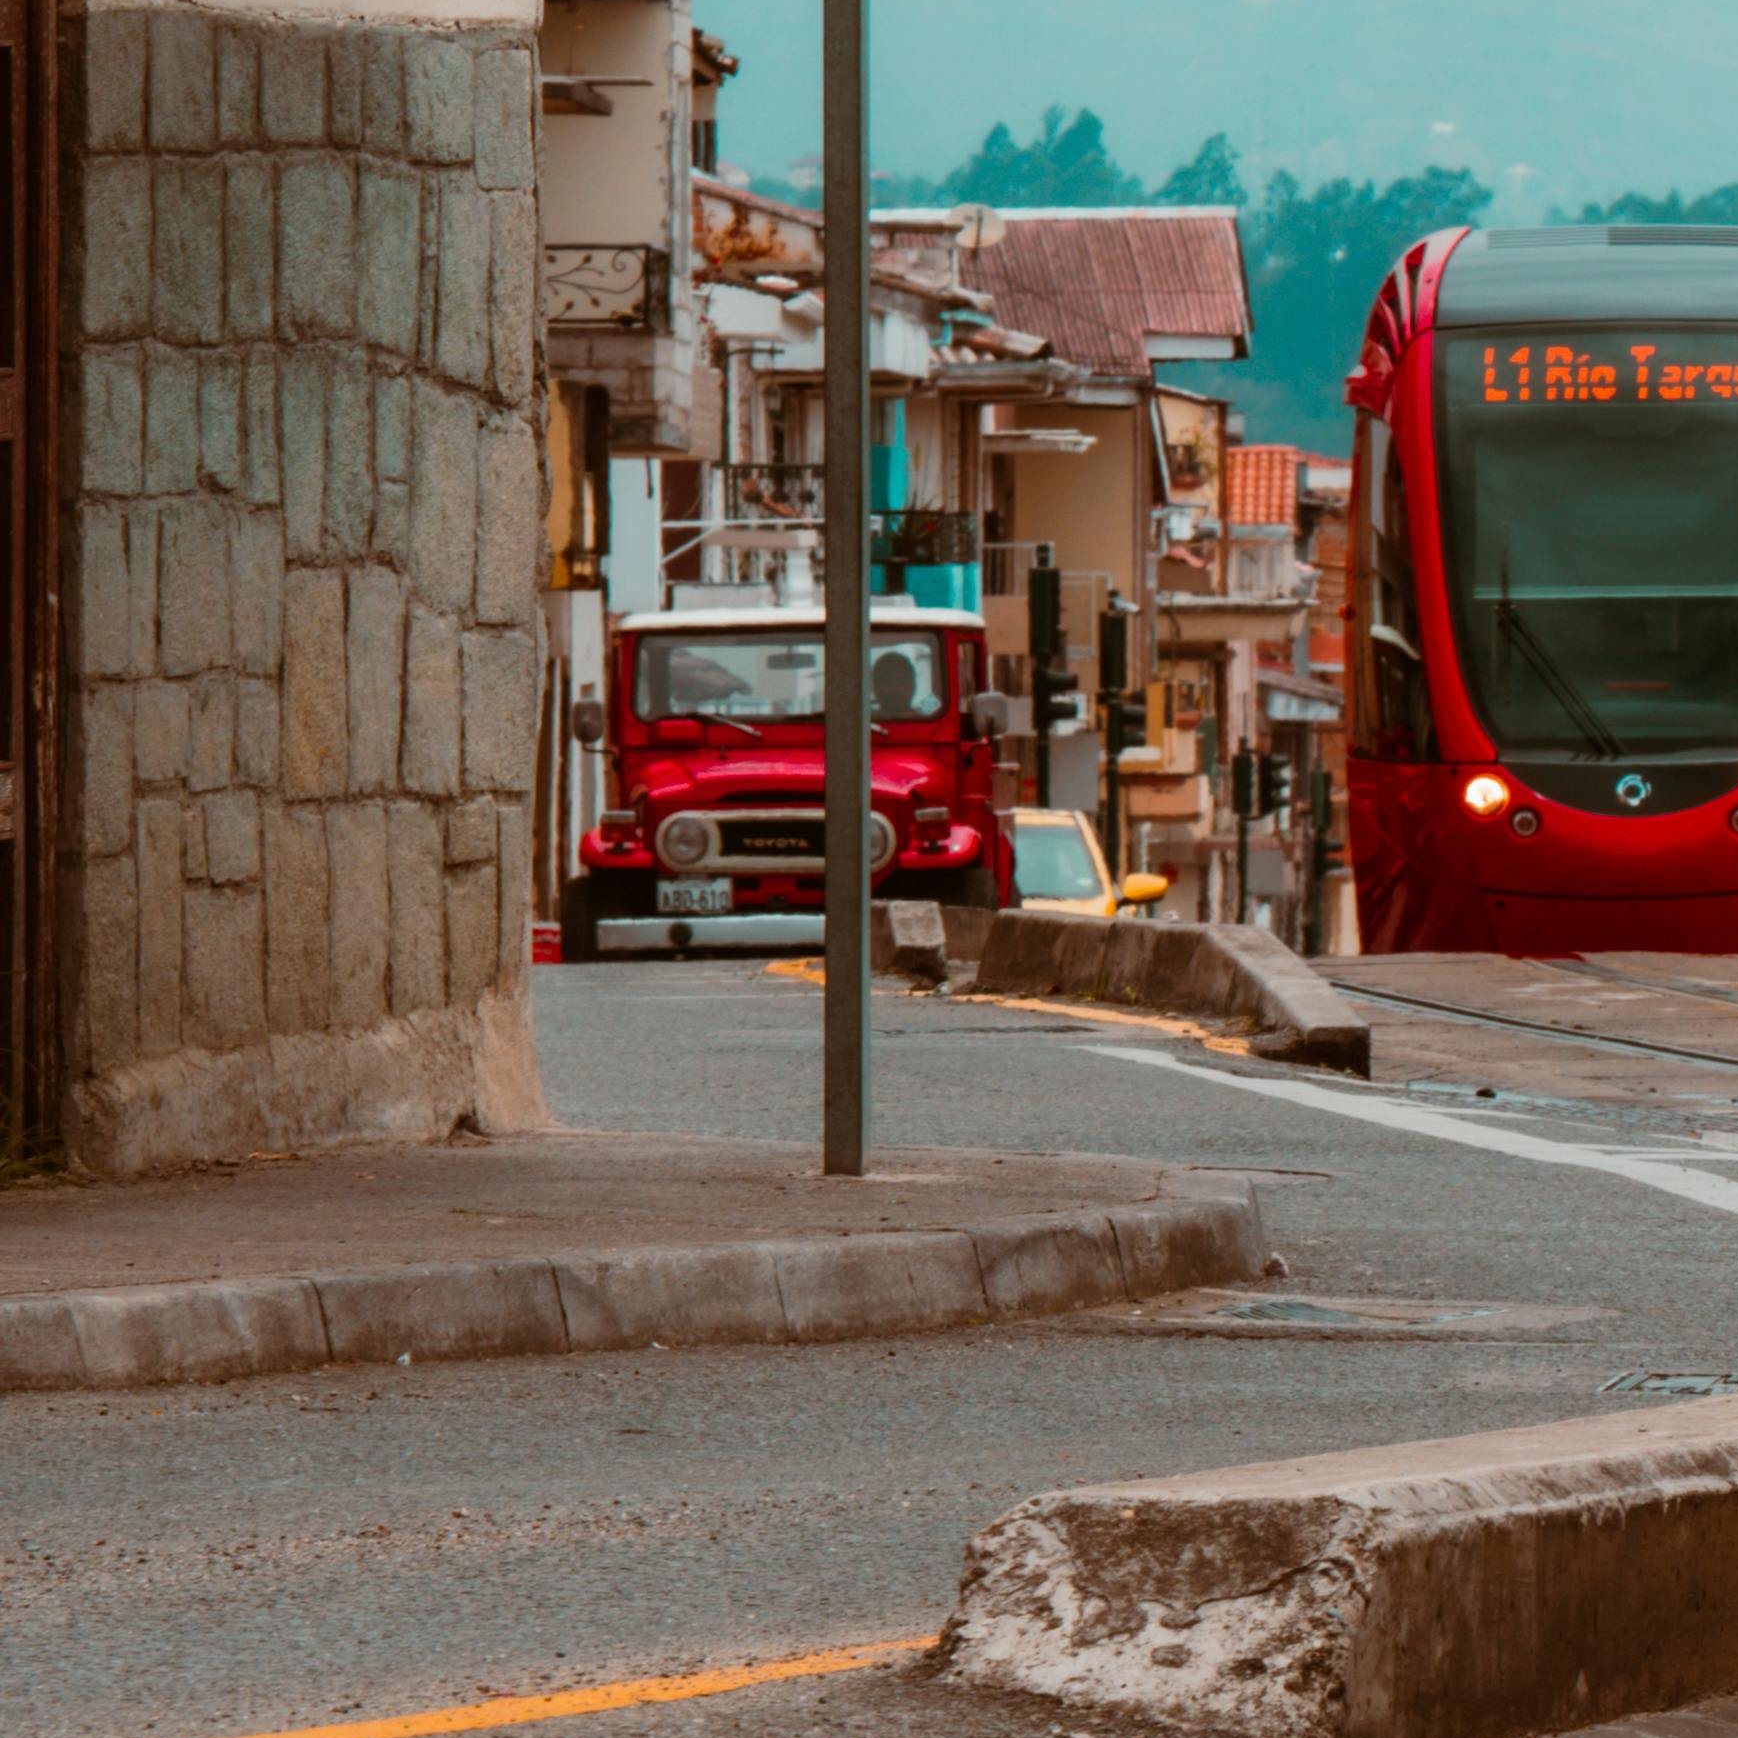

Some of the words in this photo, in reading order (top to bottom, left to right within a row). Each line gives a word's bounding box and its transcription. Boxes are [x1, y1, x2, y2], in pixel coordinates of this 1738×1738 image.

[1484, 347, 1530, 401] L1
[1545, 346, 1617, 400] Río
[742, 838, 809, 848] TOYOTA
